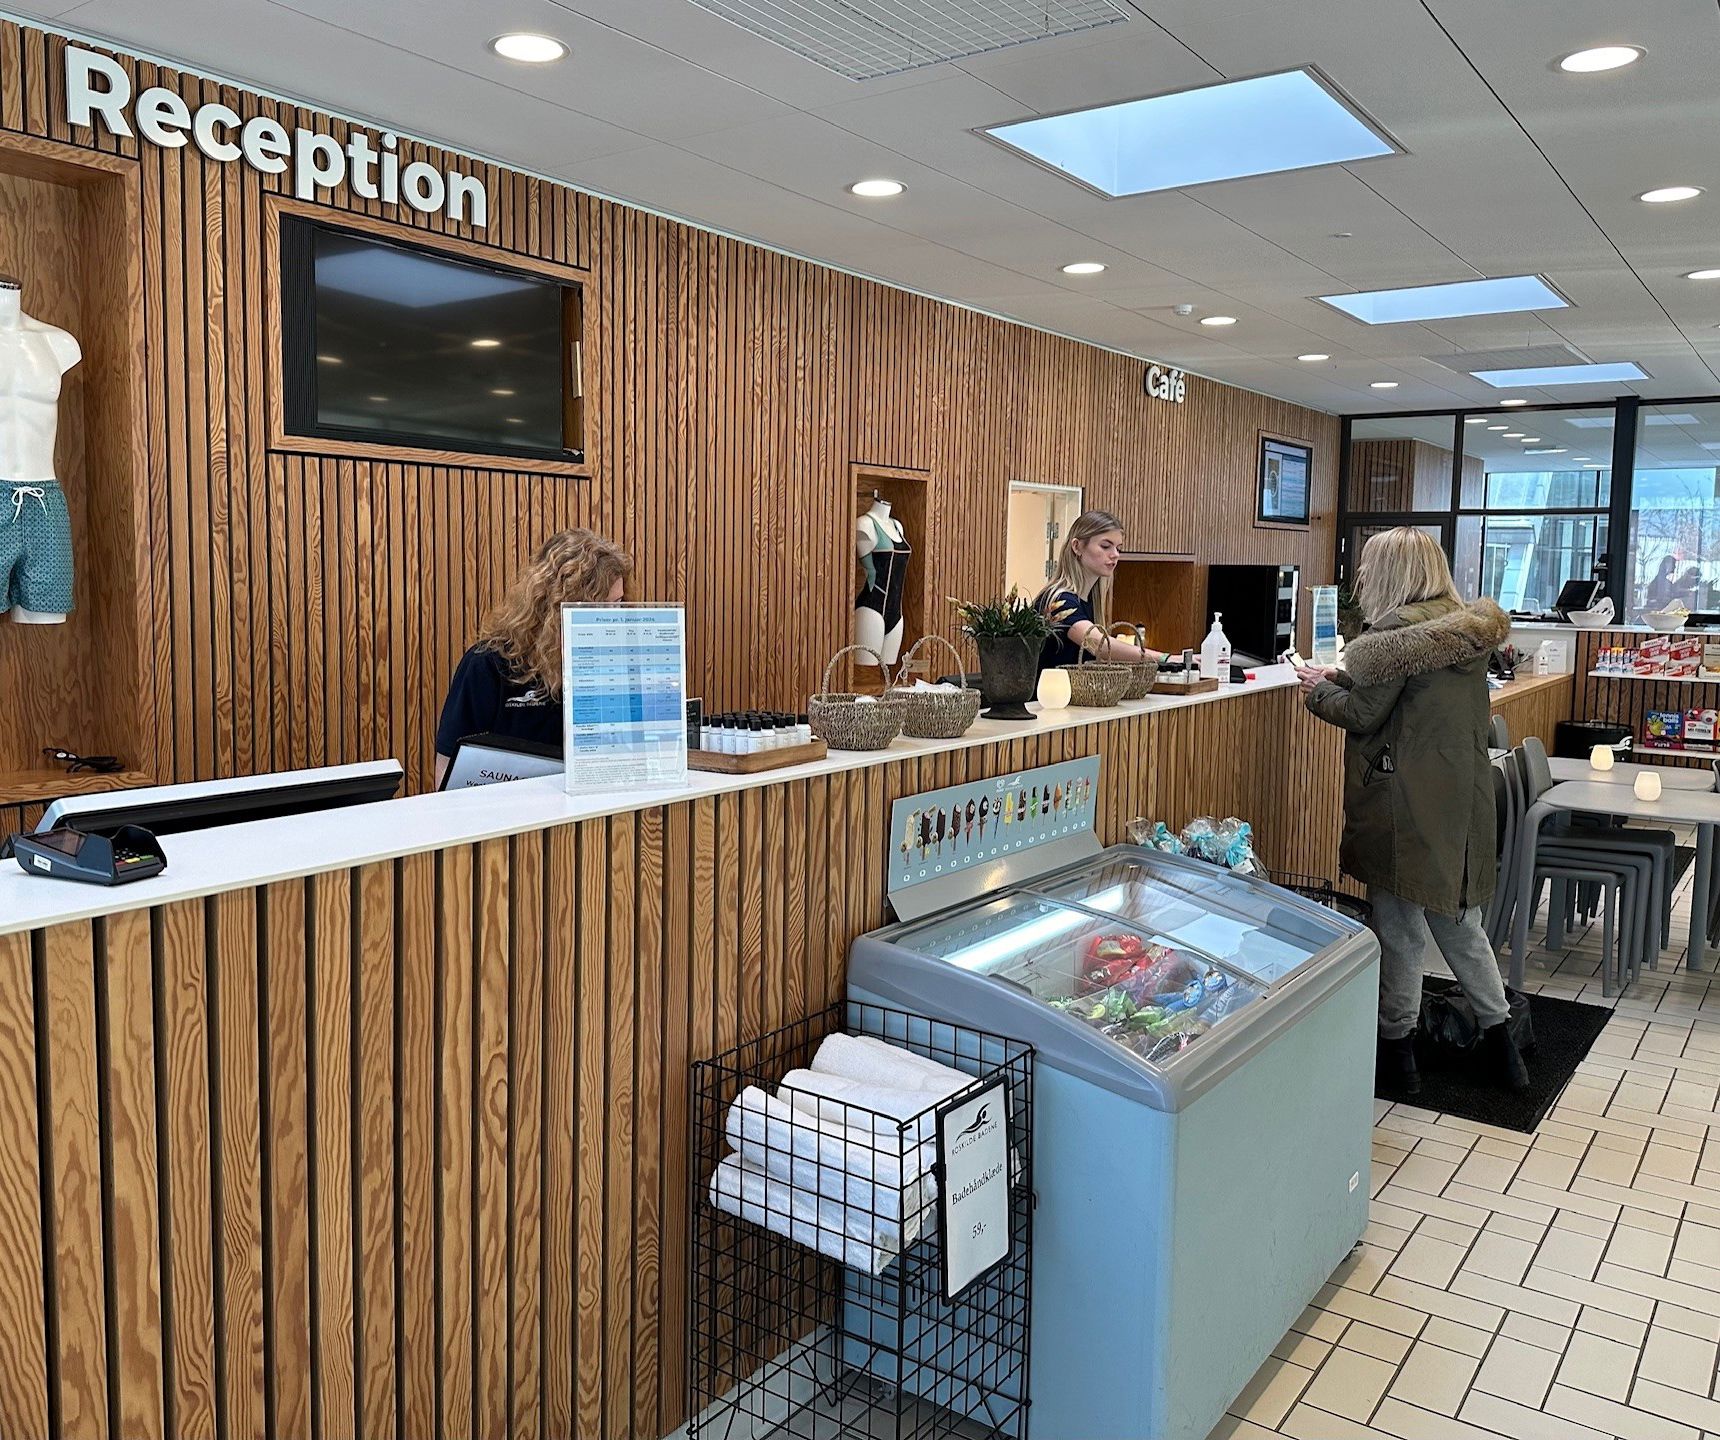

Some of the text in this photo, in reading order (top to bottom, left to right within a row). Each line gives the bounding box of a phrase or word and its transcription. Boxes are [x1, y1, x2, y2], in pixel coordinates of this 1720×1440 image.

[65, 45, 487, 229] Reception
[1145, 365, 1186, 404] Café
[951, 1121, 998, 1156] ROSKILDE BADENE
[952, 1162, 1003, 1206] Badehåndklæde
[972, 1221, 987, 1239] 59,-
